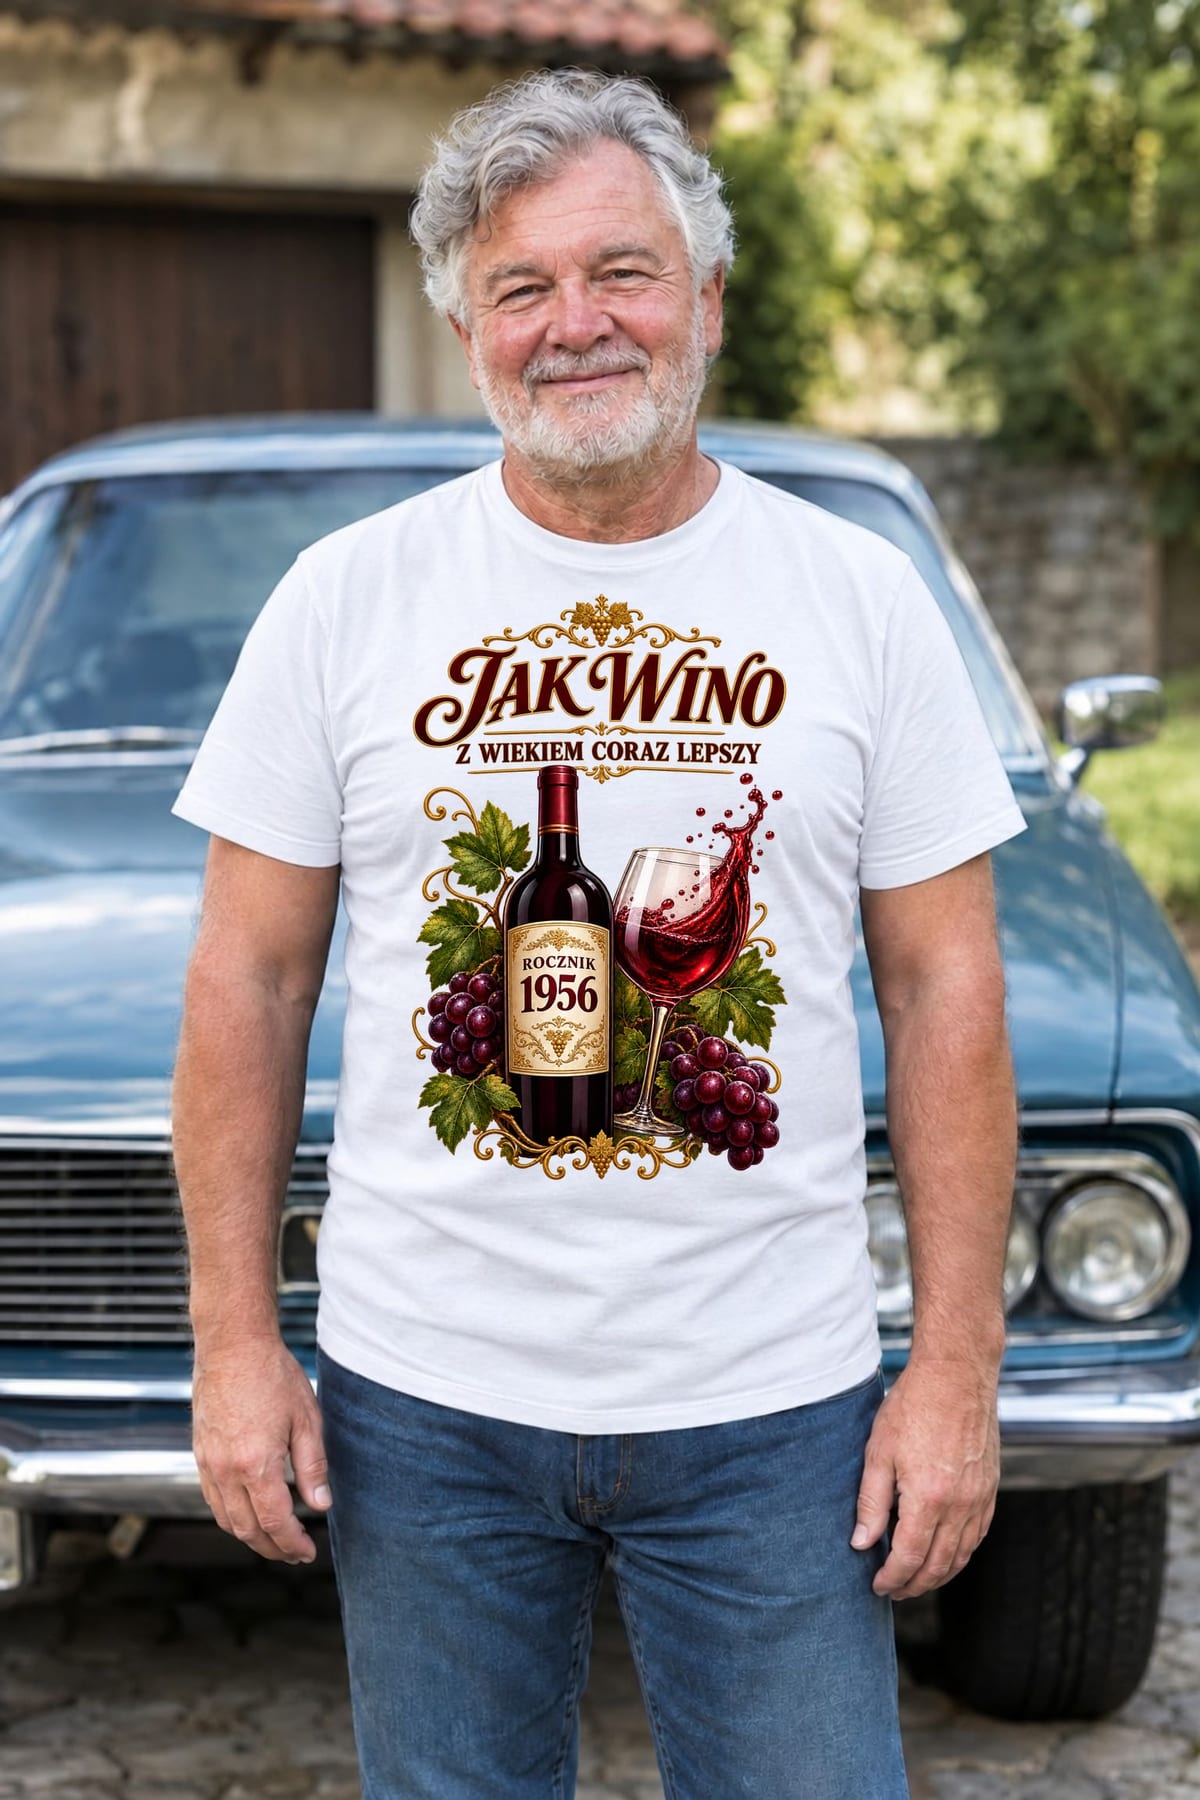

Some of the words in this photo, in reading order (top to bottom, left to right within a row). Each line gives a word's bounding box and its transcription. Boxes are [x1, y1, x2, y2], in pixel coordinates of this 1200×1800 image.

[413, 645, 596, 748] JAK
[587, 647, 787, 728] WINO
[455, 743, 472, 765] Z
[478, 741, 584, 763] WIEKIEM
[591, 740, 670, 762] CORAZ
[677, 742, 762, 764] LEPSZY
[522, 955, 597, 971] ROCZNIK
[520, 973, 598, 1013] 1956
